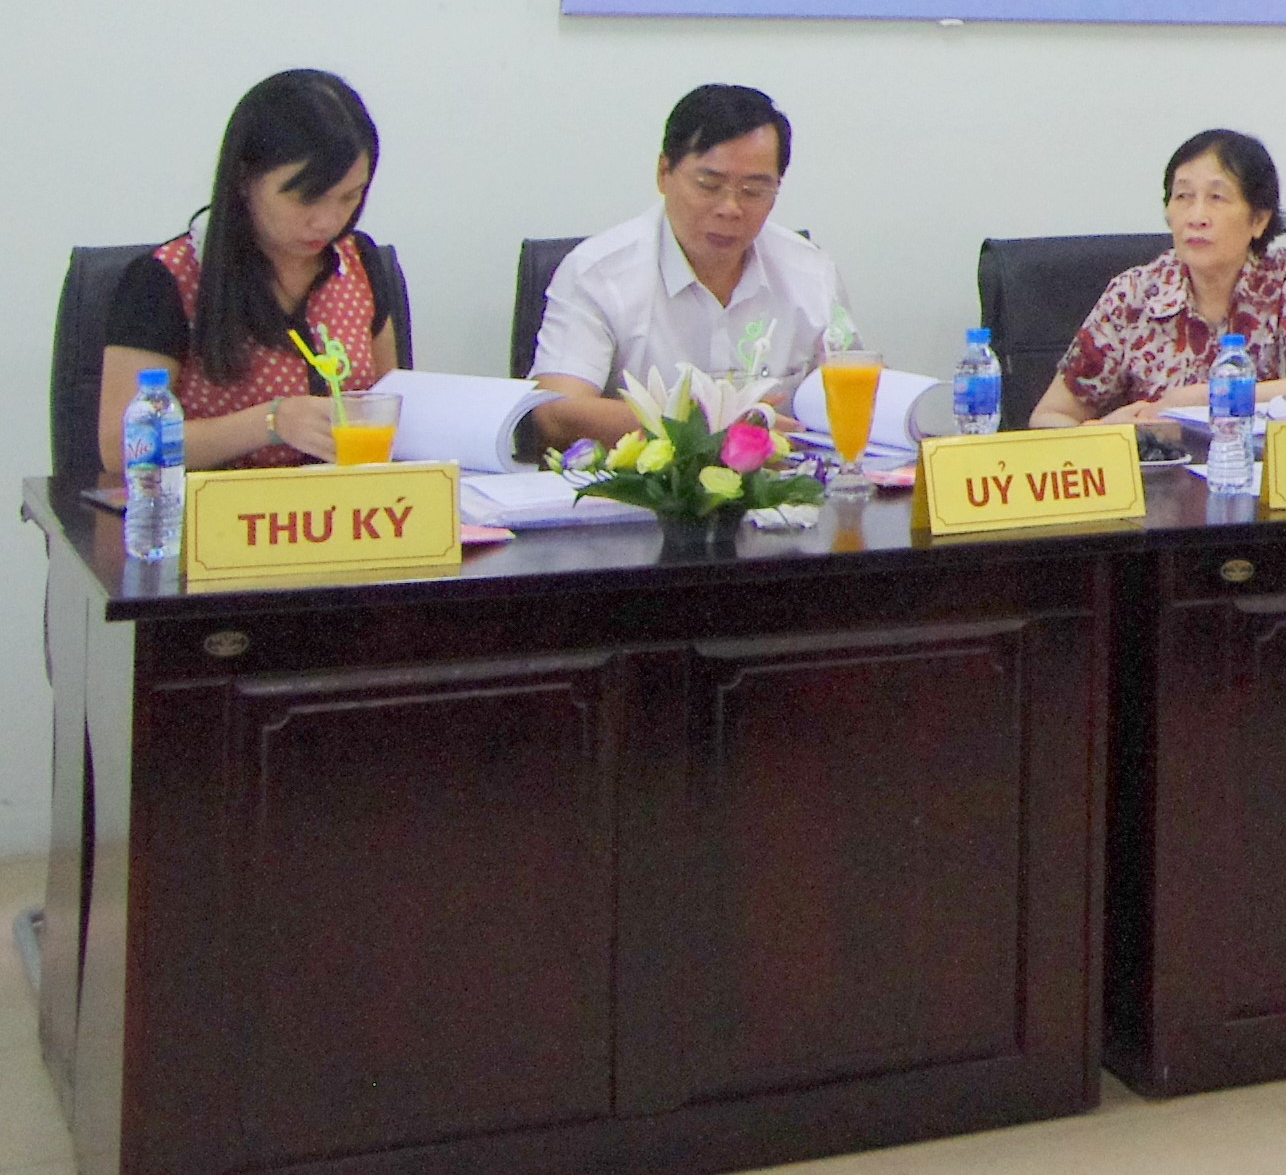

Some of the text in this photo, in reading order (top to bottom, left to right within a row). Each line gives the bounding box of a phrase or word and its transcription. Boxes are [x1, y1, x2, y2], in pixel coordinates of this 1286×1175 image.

[965, 460, 1107, 508] UỶ VIÊN
[237, 496, 414, 546] THƯ KÝ
